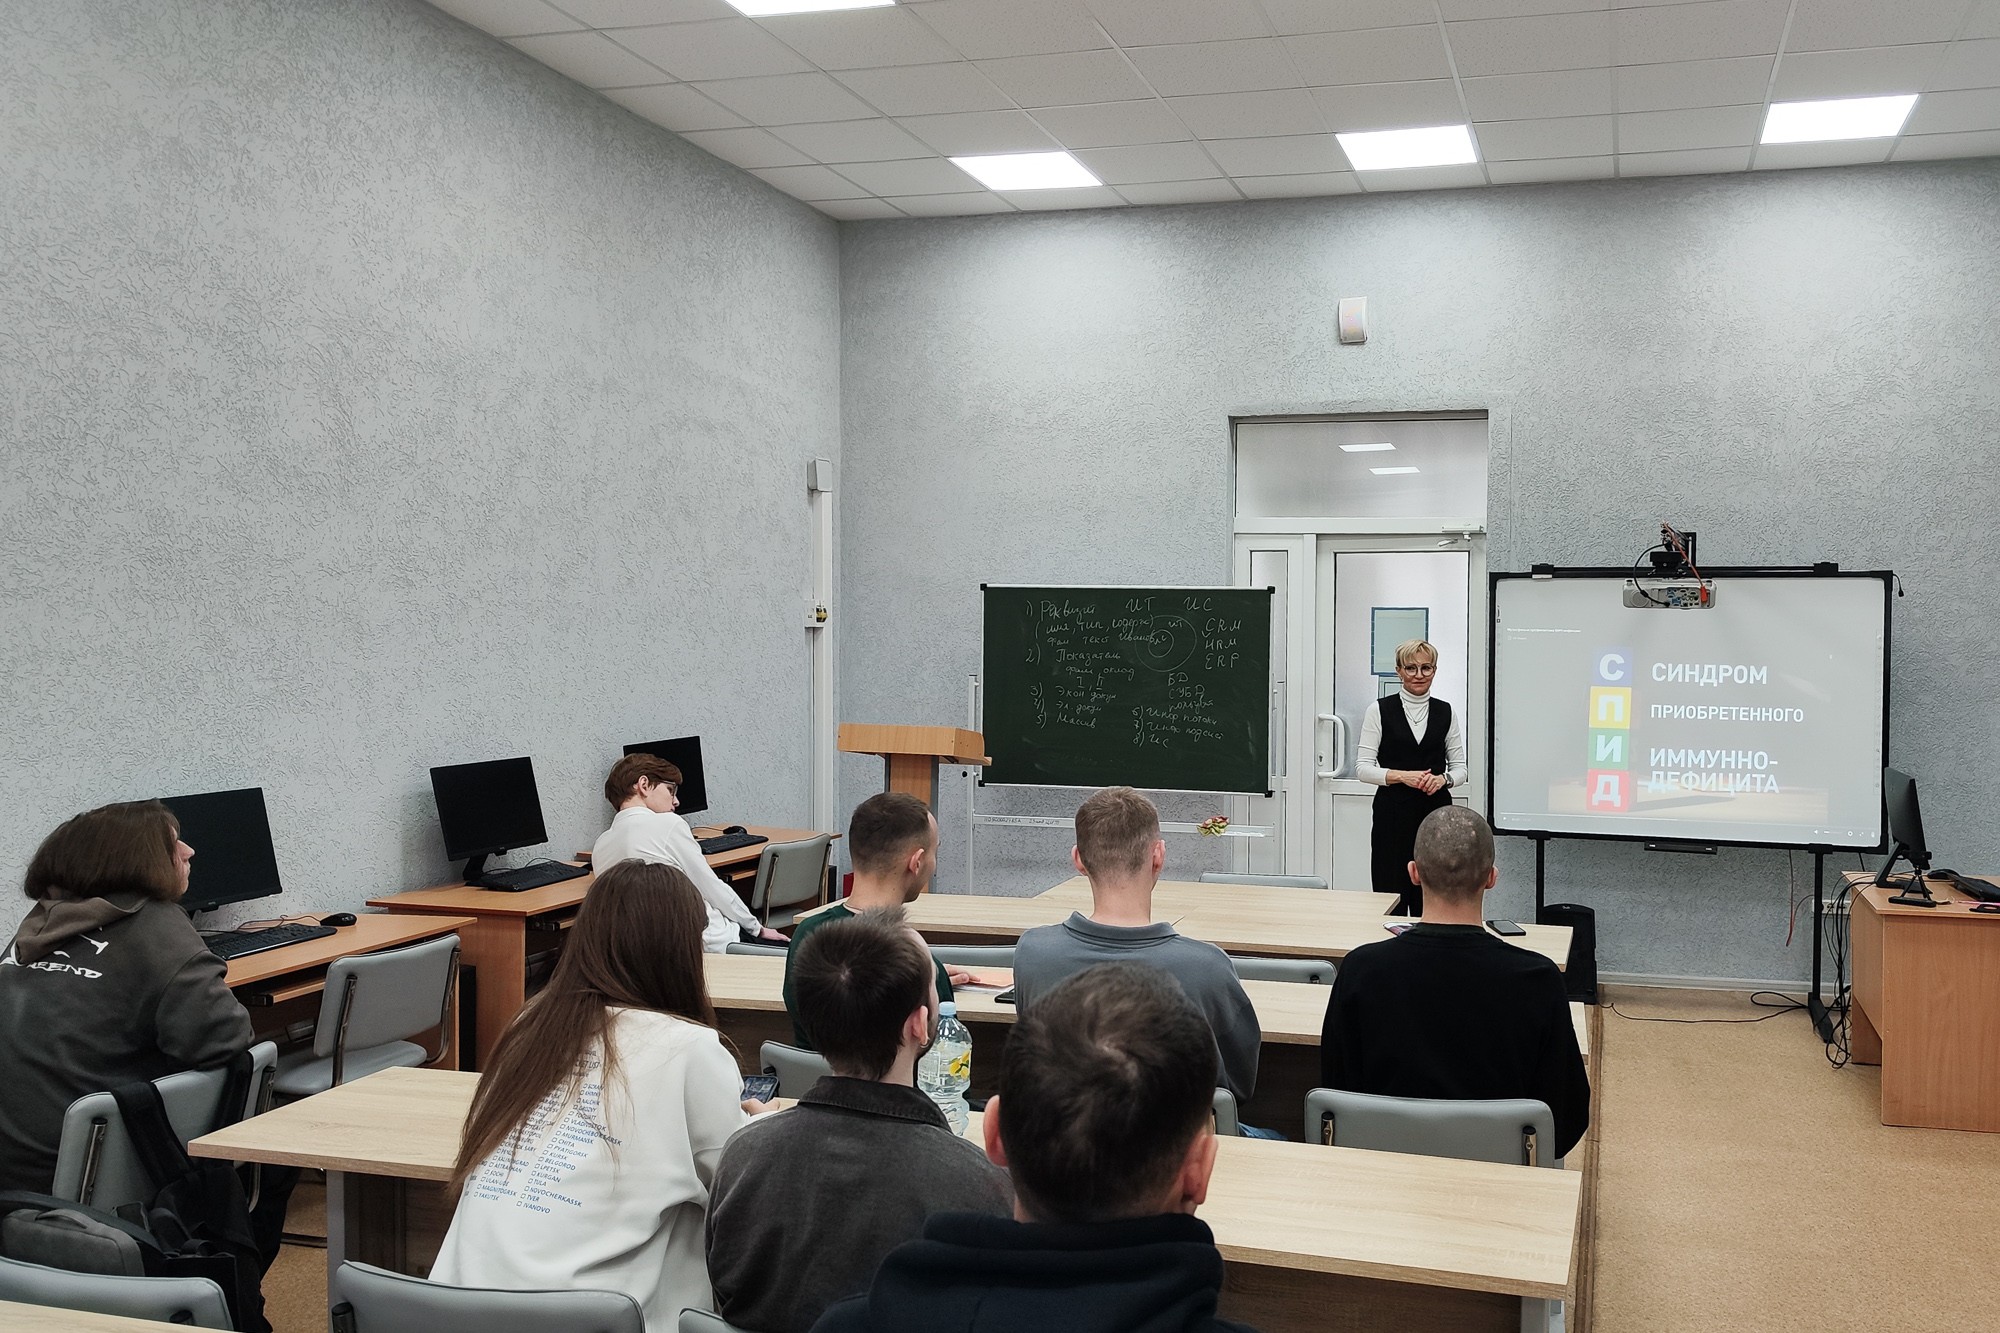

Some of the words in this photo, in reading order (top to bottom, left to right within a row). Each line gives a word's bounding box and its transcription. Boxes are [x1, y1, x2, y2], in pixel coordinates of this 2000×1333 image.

[1205, 618, 1241, 633] CRM
[1205, 639, 1237, 651] HRM
[1205, 653, 1240, 670] ERP
[1651, 662, 1768, 687] СИНДРОМ
[1650, 704, 1804, 723] ПРИОБРЕТЕННОГО
[1650, 748, 1778, 770] ИММУННО-
[1648, 770, 1780, 796] ДЕФИЦИТА
[558, 1139, 575, 1148] CHITA
[561, 1132, 594, 1145] MURMANSK
[548, 1152, 568, 1161] KURSK
[553, 1145, 589, 1158] PYATIGORSK
[544, 1158, 576, 1171] BELGOROD
[533, 1179, 547, 1187] TULA
[536, 1172, 562, 1183] KURGAN
[526, 1194, 540, 1202] TVER
[529, 1187, 582, 1208] NOVOCHERKASSK
[522, 1203, 551, 1214] IVANOVO
